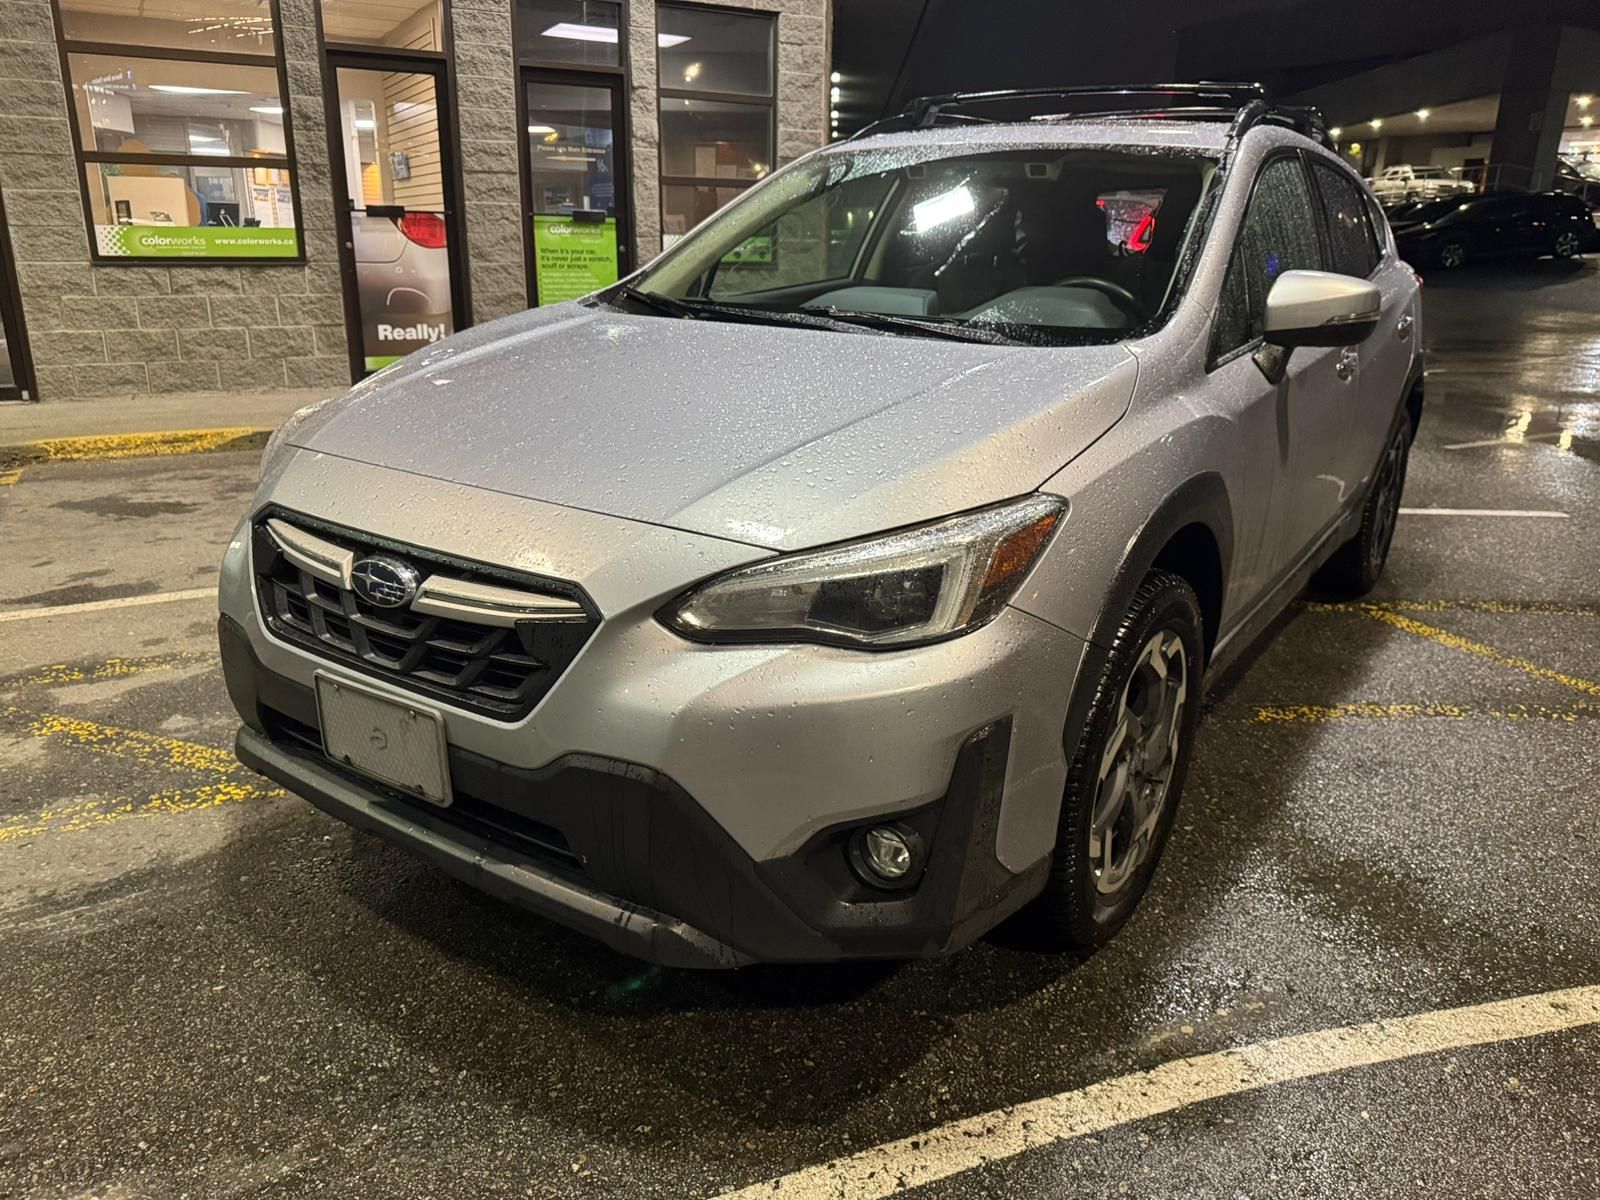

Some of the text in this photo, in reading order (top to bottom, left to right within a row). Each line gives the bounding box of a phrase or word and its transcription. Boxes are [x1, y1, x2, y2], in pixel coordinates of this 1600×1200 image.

[550, 224, 601, 234] colorworks
[141, 235, 206, 246] colorworks
[214, 238, 294, 246] www.colorworks.ca
[570, 248, 585, 256] your
[377, 323, 446, 342] Really!
